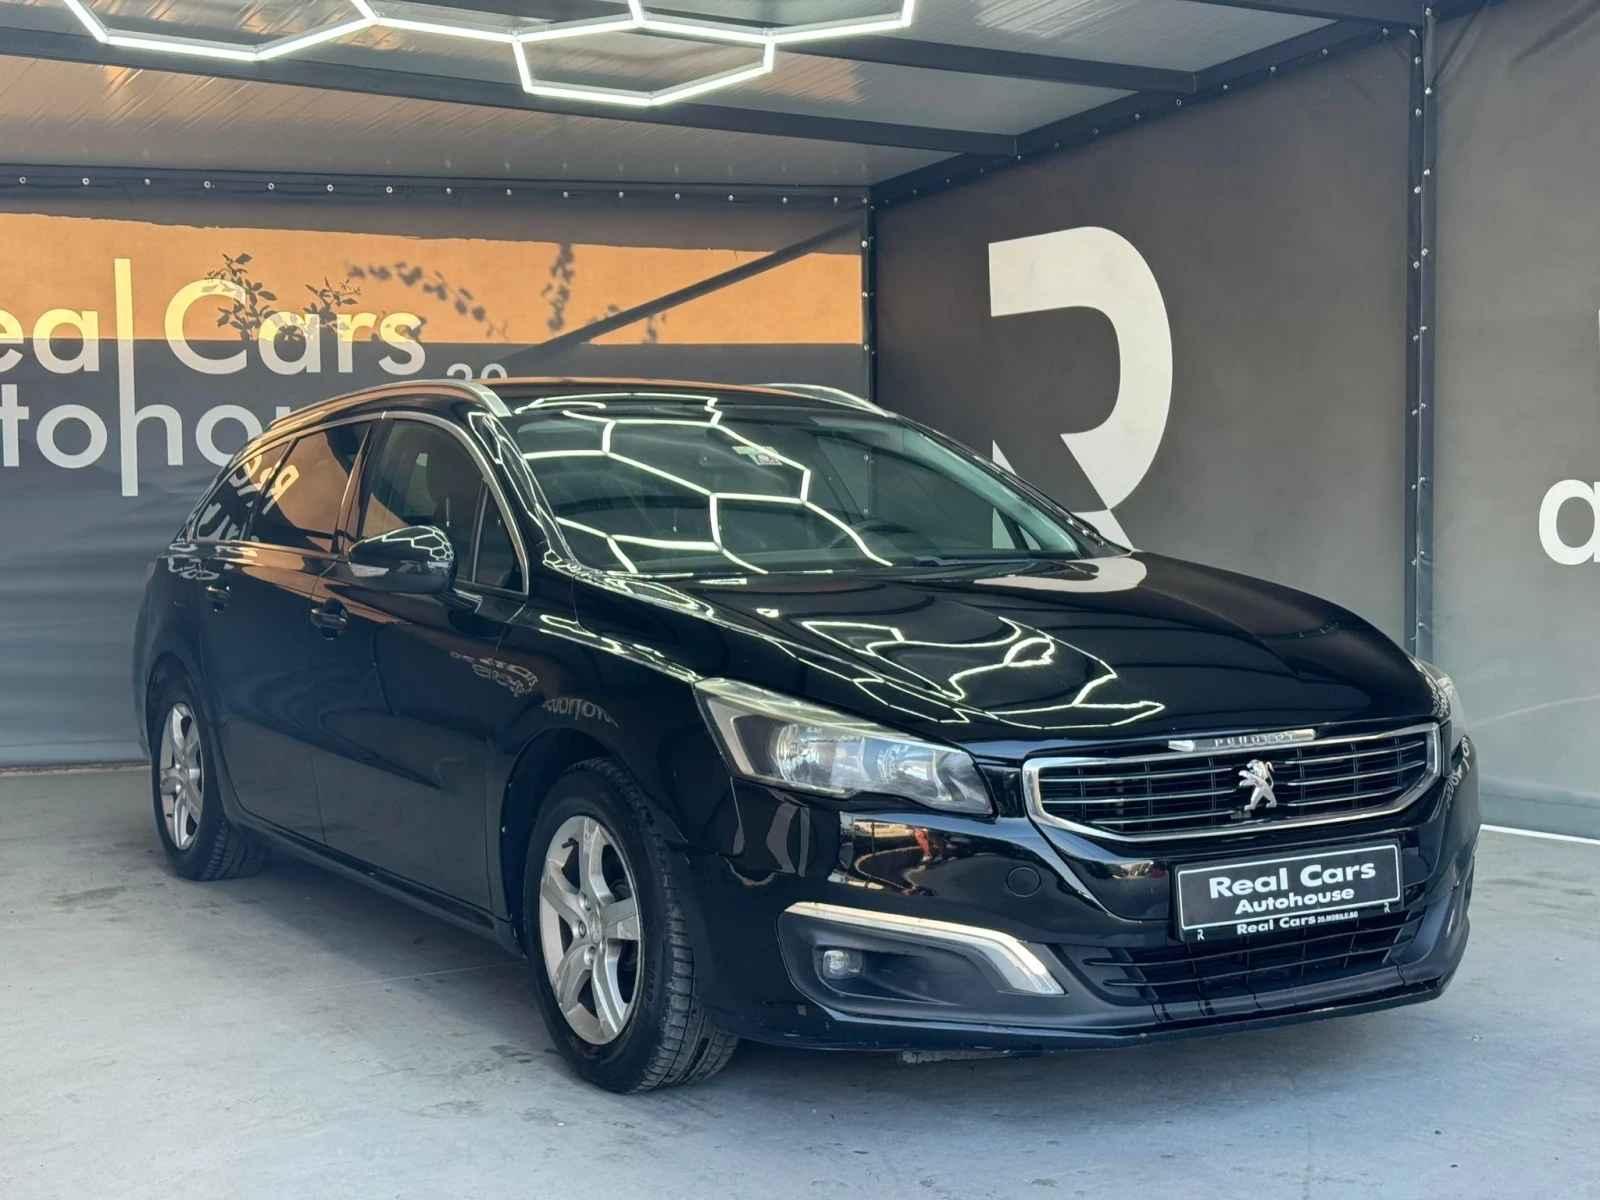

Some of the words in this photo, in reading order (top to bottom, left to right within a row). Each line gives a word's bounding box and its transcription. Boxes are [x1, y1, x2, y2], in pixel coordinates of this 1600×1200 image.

[164, 278, 426, 376] Cars
[1209, 867, 1289, 899] Real
[1300, 862, 1376, 888] Cars
[1234, 887, 1355, 915] Autohouse
[1236, 918, 1274, 935] Real
[1279, 915, 1316, 929] Cars
